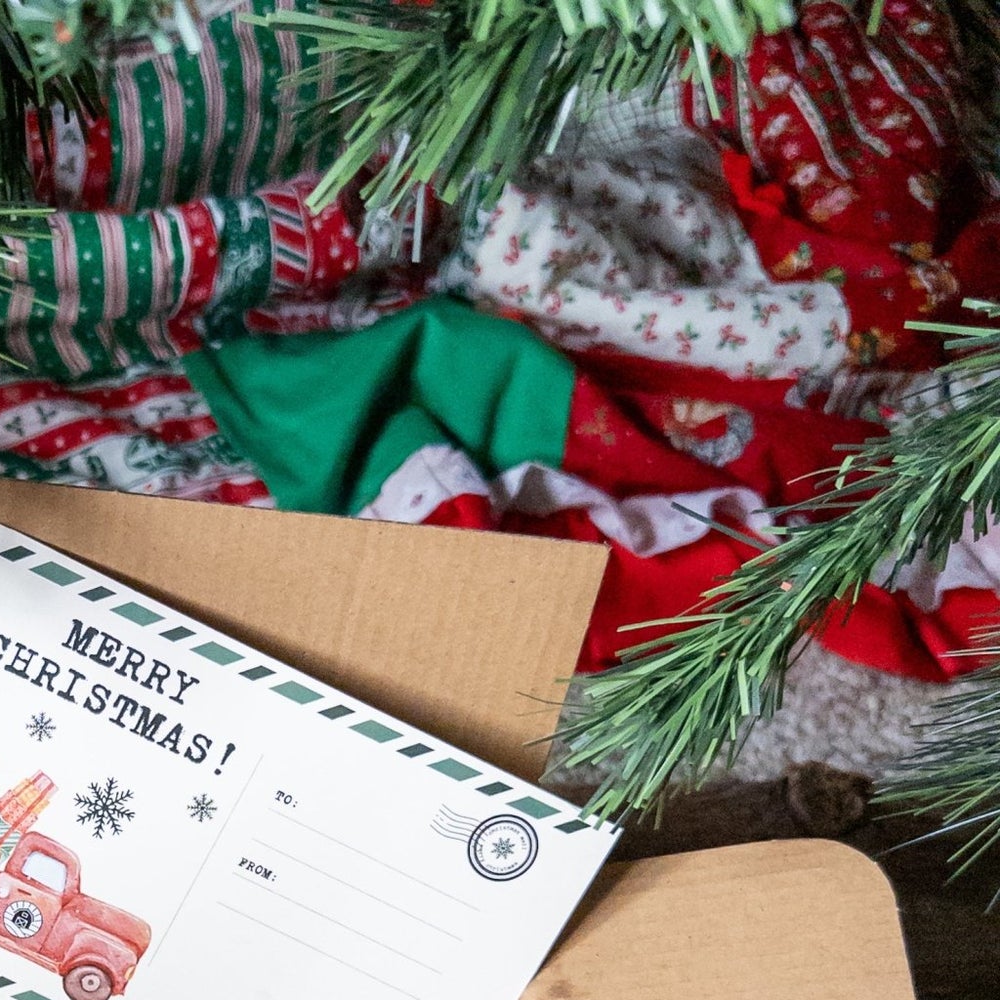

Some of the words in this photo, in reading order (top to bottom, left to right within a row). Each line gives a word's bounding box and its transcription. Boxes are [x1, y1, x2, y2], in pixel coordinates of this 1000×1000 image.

[61, 619, 200, 705] MERRY
[275, 790, 298, 807] TO:
[238, 857, 277, 882] FROM:
